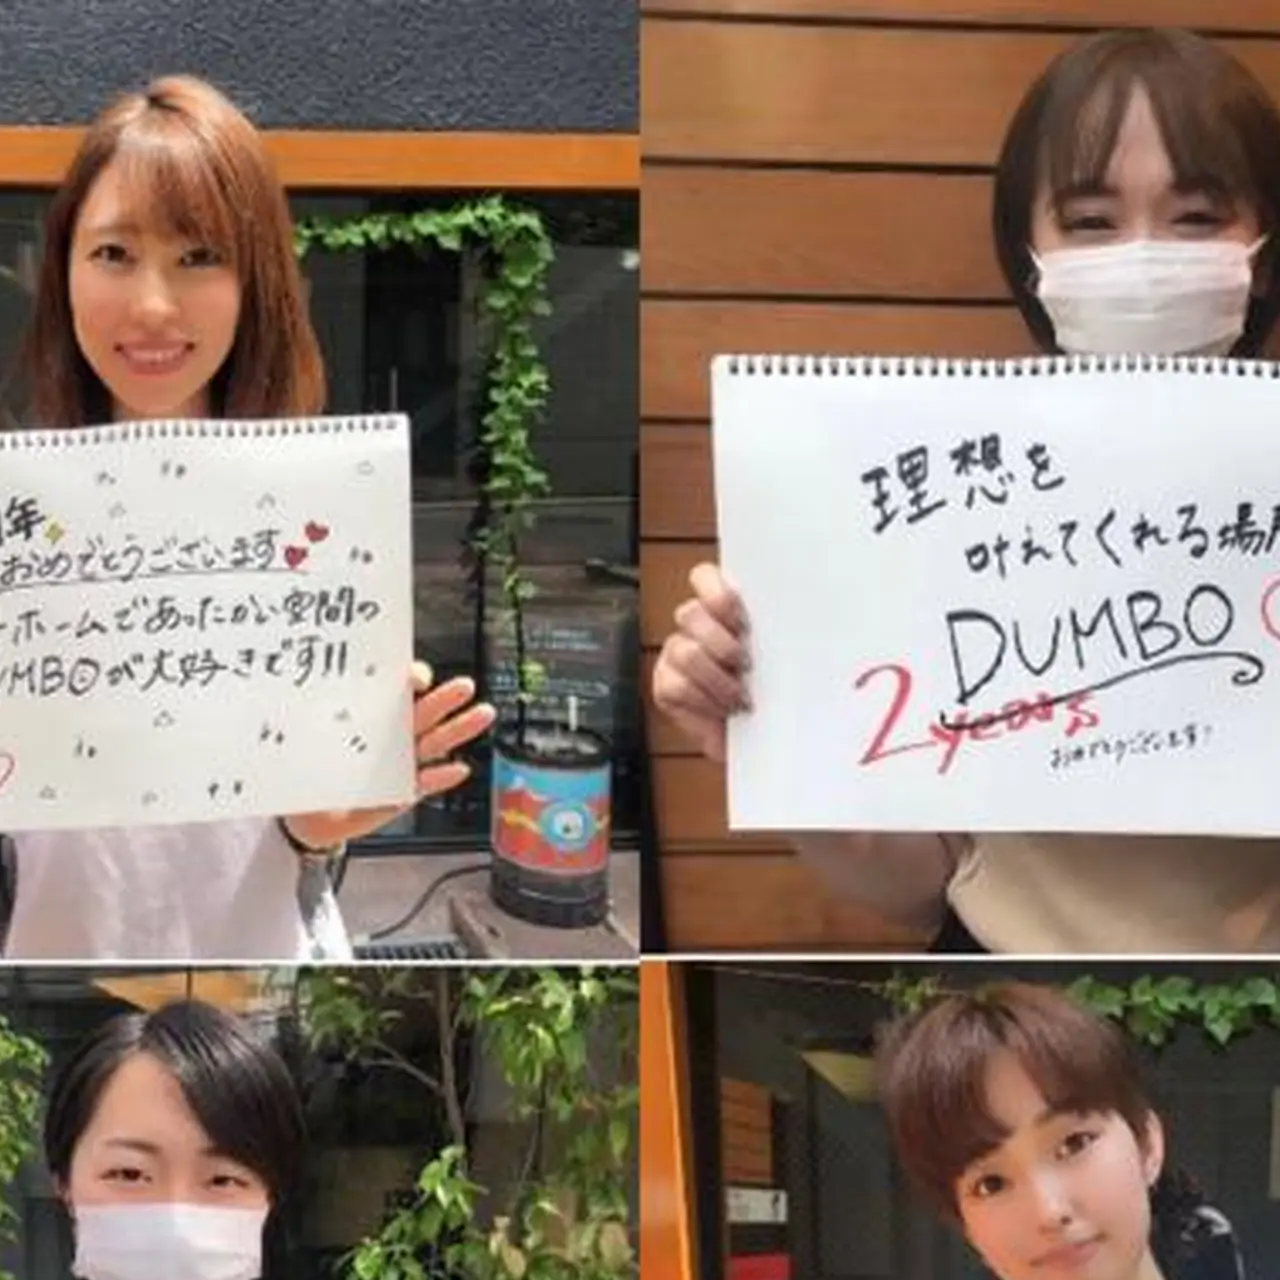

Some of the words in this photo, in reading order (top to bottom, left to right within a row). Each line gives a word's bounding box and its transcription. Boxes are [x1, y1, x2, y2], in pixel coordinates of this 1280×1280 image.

[860, 432, 1067, 535] 理想を
[945, 583, 1236, 705] DUMBO
